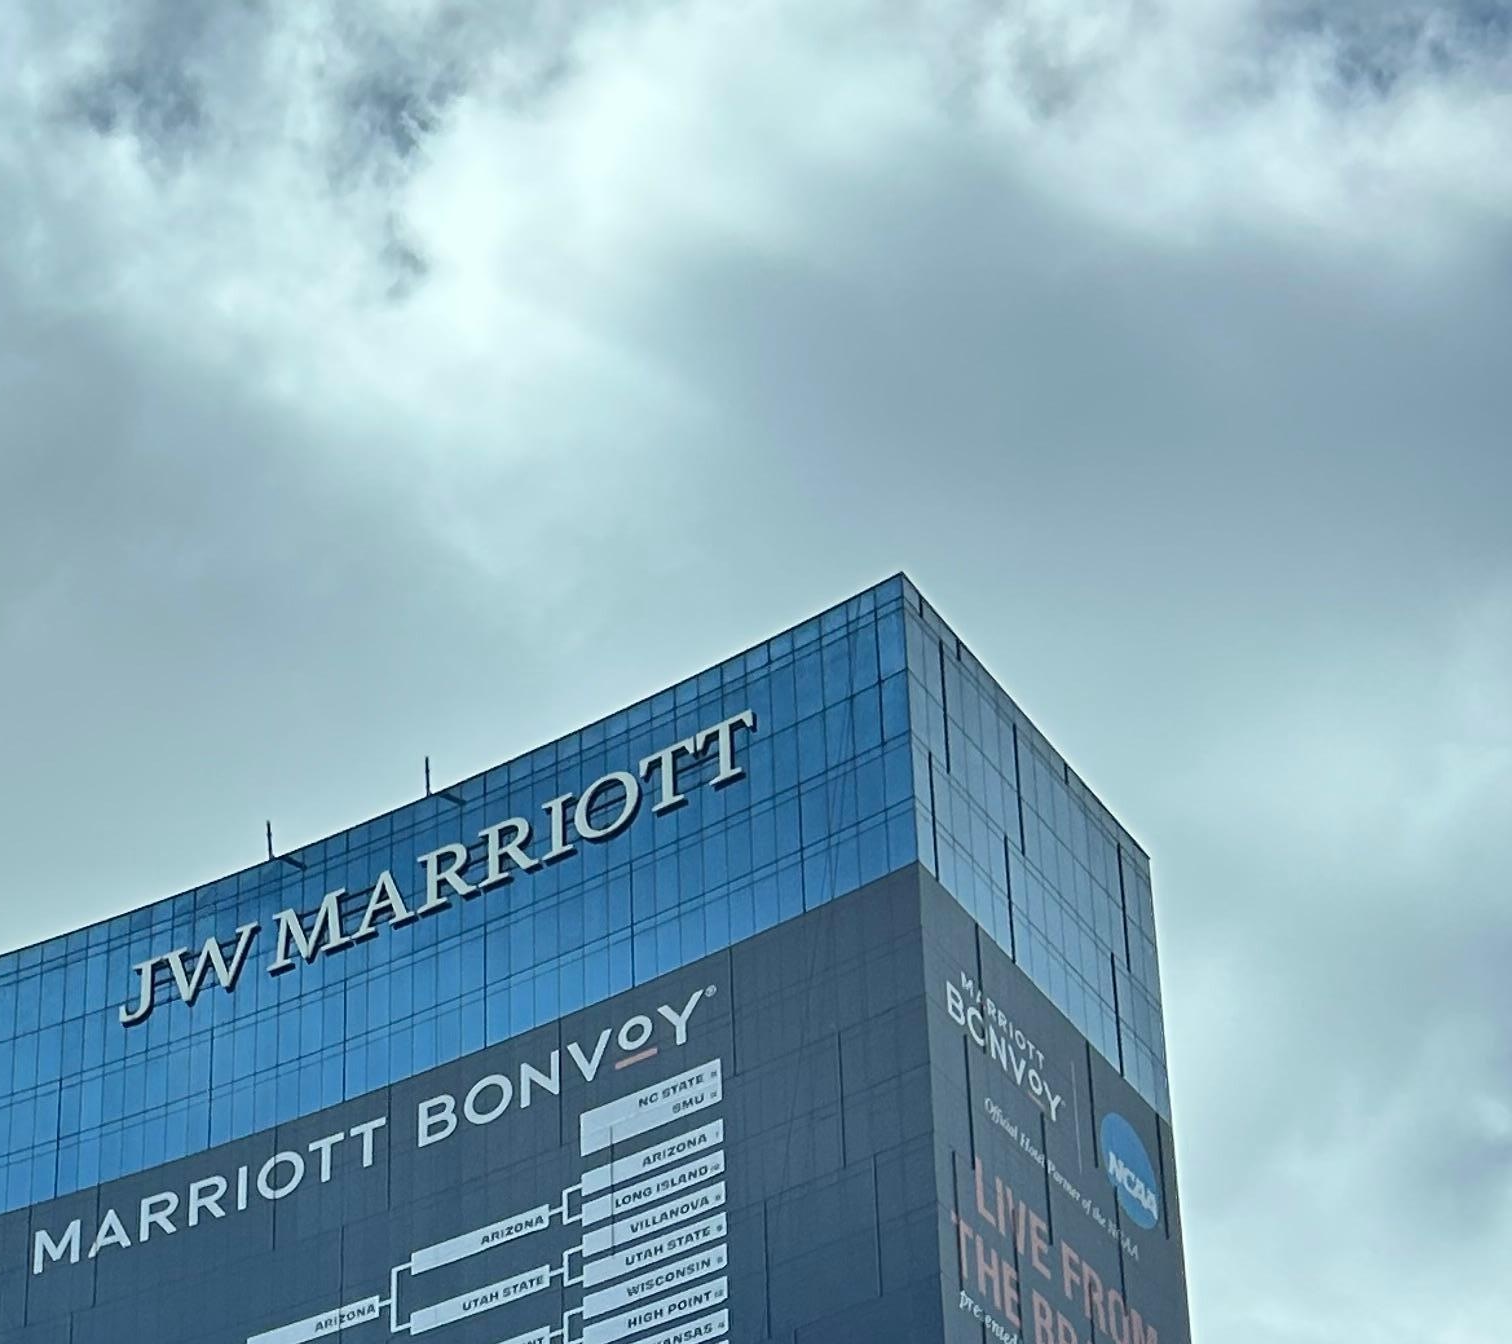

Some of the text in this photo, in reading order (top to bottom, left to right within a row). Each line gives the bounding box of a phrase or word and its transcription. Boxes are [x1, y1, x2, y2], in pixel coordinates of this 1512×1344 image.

[119, 711, 756, 1026] JW MARRIOTT
[34, 1117, 387, 1273] MARRIOTT
[480, 1215, 544, 1245] ARIZONA
[629, 1196, 709, 1234] VILLANOVA
[975, 1157, 1051, 1280] LIVE
[462, 1275, 544, 1312] UTAH STATE
[626, 1257, 712, 1297] WISCONSIN
[952, 1210, 1022, 1329] THE
